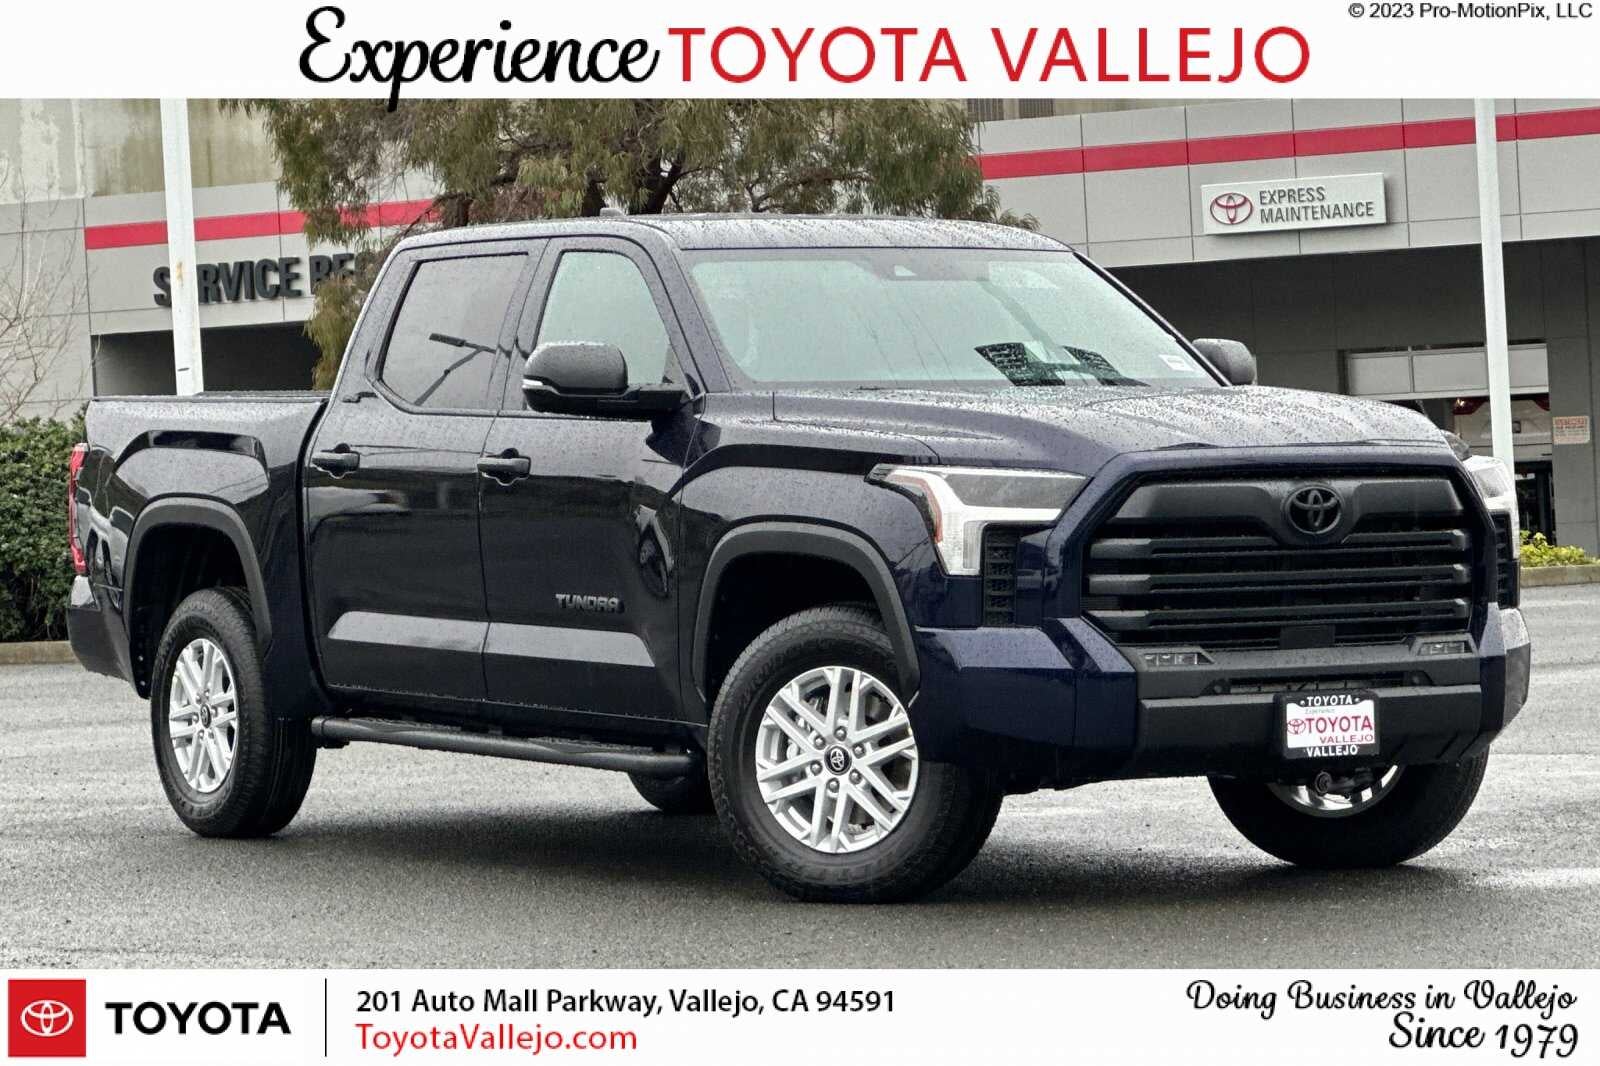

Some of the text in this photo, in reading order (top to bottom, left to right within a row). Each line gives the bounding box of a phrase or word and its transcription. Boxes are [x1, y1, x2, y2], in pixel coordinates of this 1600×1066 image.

[1259, 186, 1326, 205] EXPRESS
[1259, 201, 1374, 224] MAINTENANCE
[153, 257, 301, 306] SRVICE
[555, 593, 621, 612] TUNDRA
[1306, 694, 1353, 707] TOYOTA
[1305, 715, 1373, 734] TOYOTA
[1319, 734, 1374, 744] VALLEJO
[1306, 744, 1359, 758] VALLEJO
